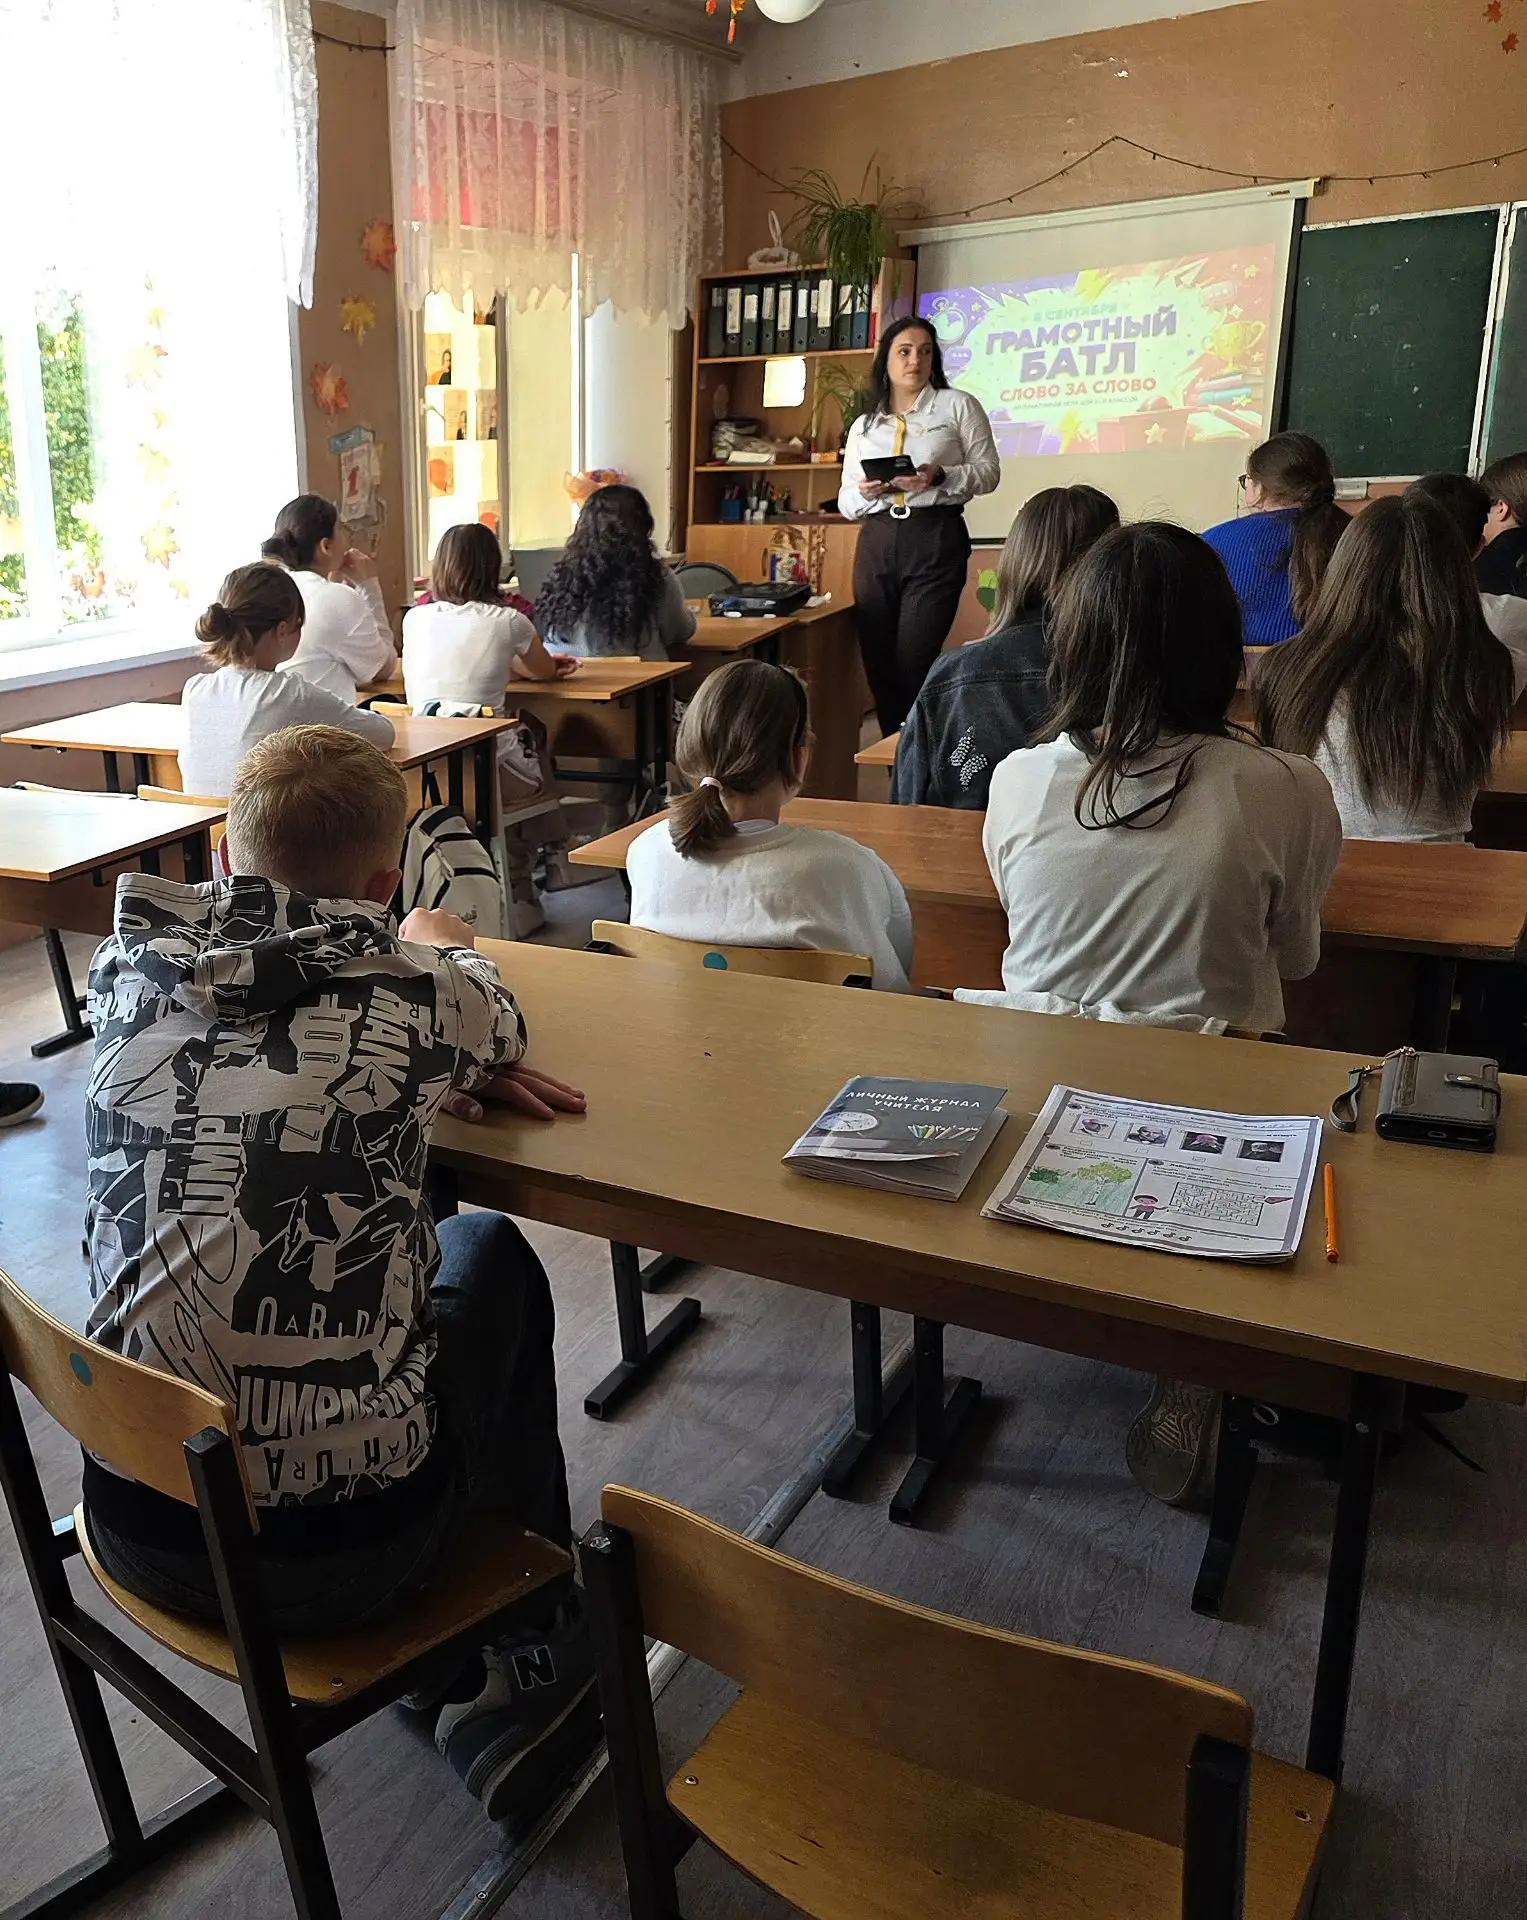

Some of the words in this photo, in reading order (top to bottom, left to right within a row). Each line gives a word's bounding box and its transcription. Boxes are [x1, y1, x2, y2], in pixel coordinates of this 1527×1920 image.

[1045, 303, 1118, 321] СЕНТЯБРЯ
[986, 304, 1178, 356] ГРАМОТНЫЙ
[1019, 341, 1136, 383] БАТЛ
[1000, 384, 1060, 402] СЛОВО
[1065, 382, 1087, 396] ЗА
[1093, 377, 1157, 394] СЛОВО
[845, 1091, 909, 1103] ЛИЧНЫЙ
[914, 1096, 980, 1108] ЖУРНАЛ
[873, 1099, 943, 1113] УЧИТЕЛЯ
[511, 1644, 558, 1691] N
